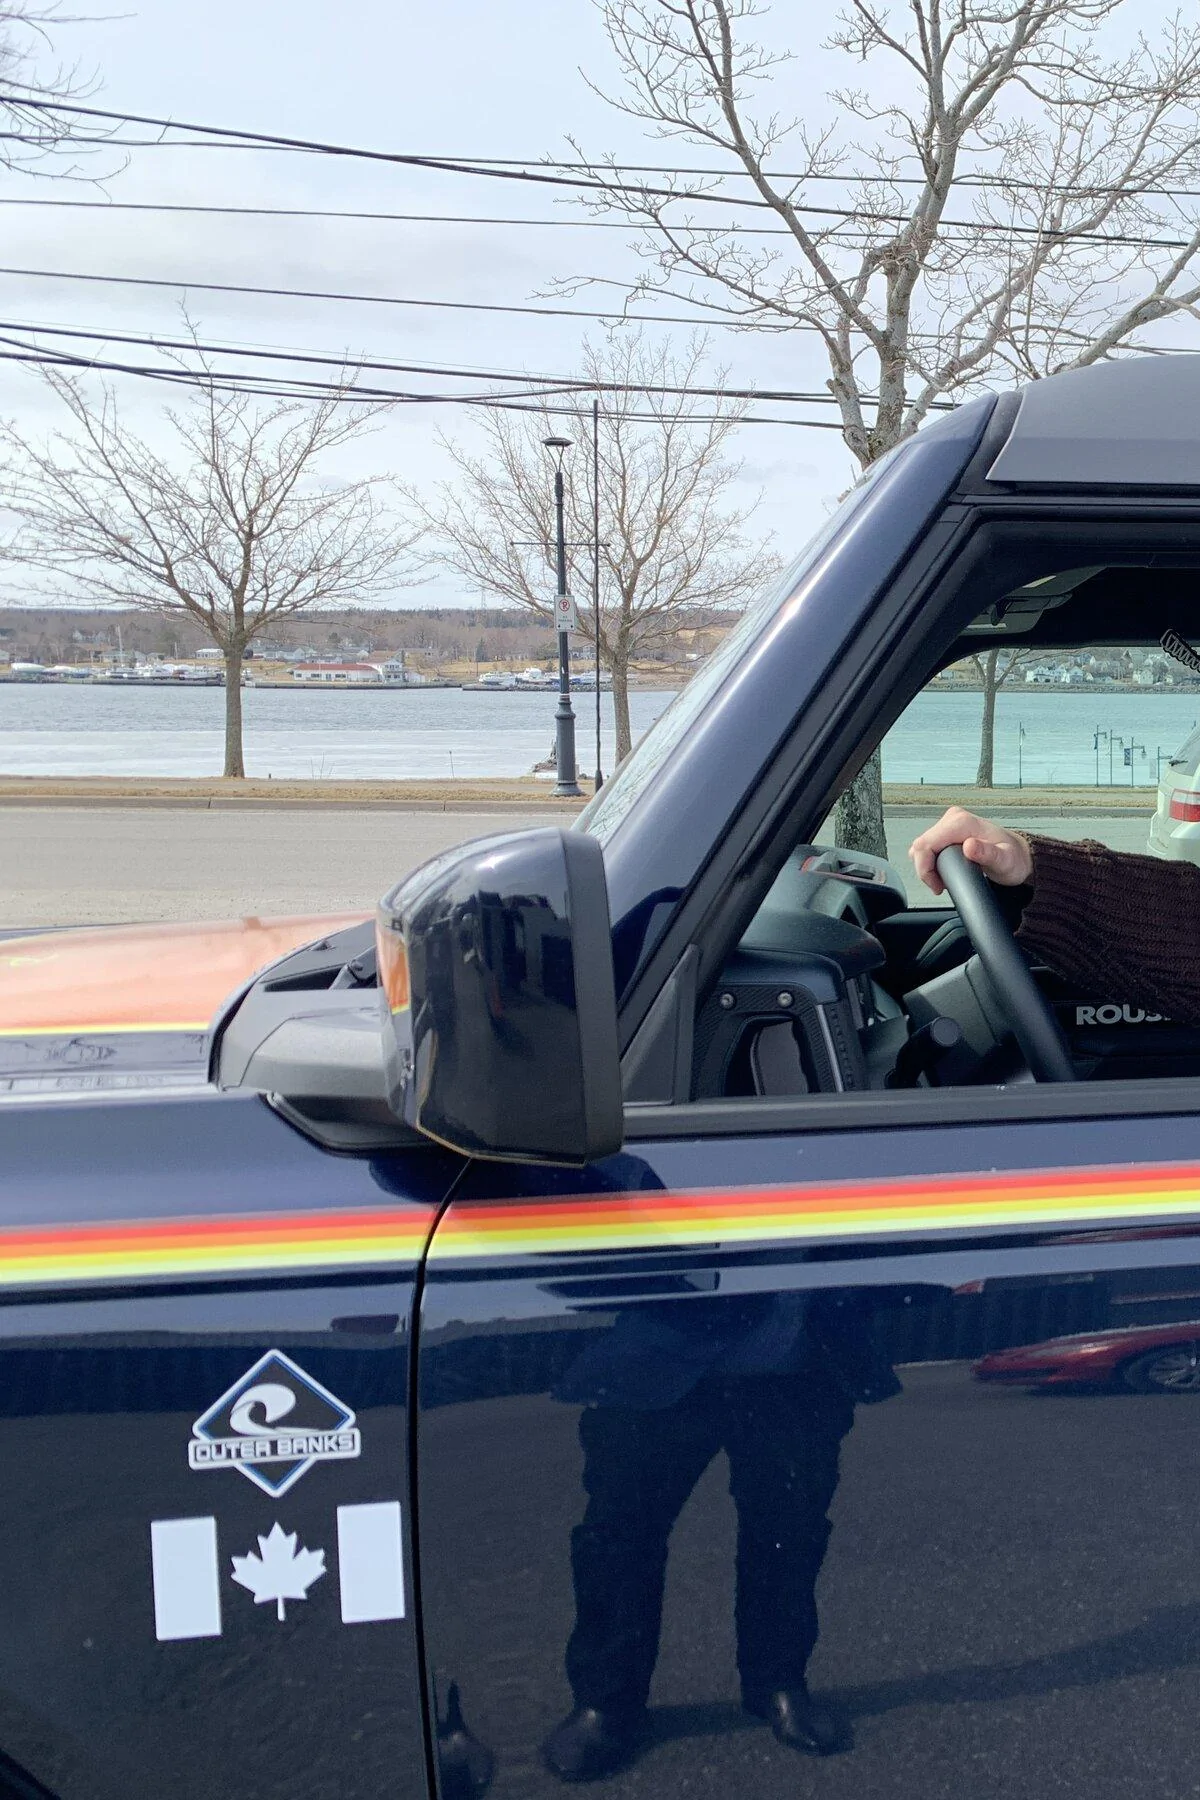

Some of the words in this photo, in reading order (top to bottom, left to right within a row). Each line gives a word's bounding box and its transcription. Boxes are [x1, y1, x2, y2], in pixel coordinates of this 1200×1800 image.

[1076, 1003, 1171, 1025] ROU
[196, 1440, 271, 1462] OUTER
[277, 1434, 353, 1456] BANKS
